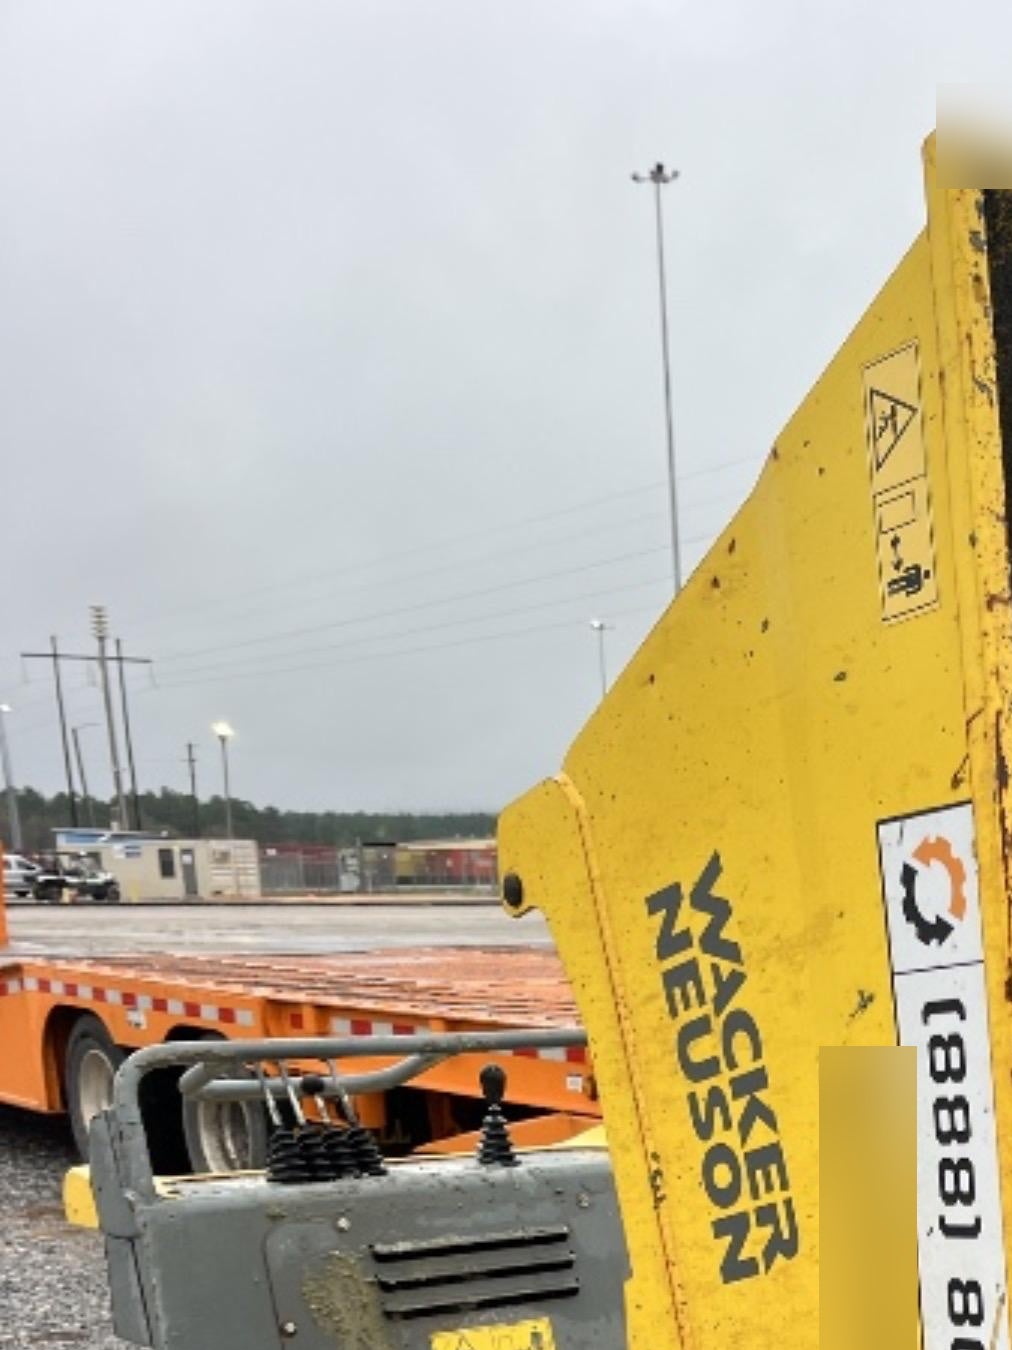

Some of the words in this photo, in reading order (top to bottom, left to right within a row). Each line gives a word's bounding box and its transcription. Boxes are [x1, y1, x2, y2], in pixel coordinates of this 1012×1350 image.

[645, 882, 760, 1284] NEUSON
[689, 850, 800, 1274] WACKER
[921, 998, 983, 1239] (888)
